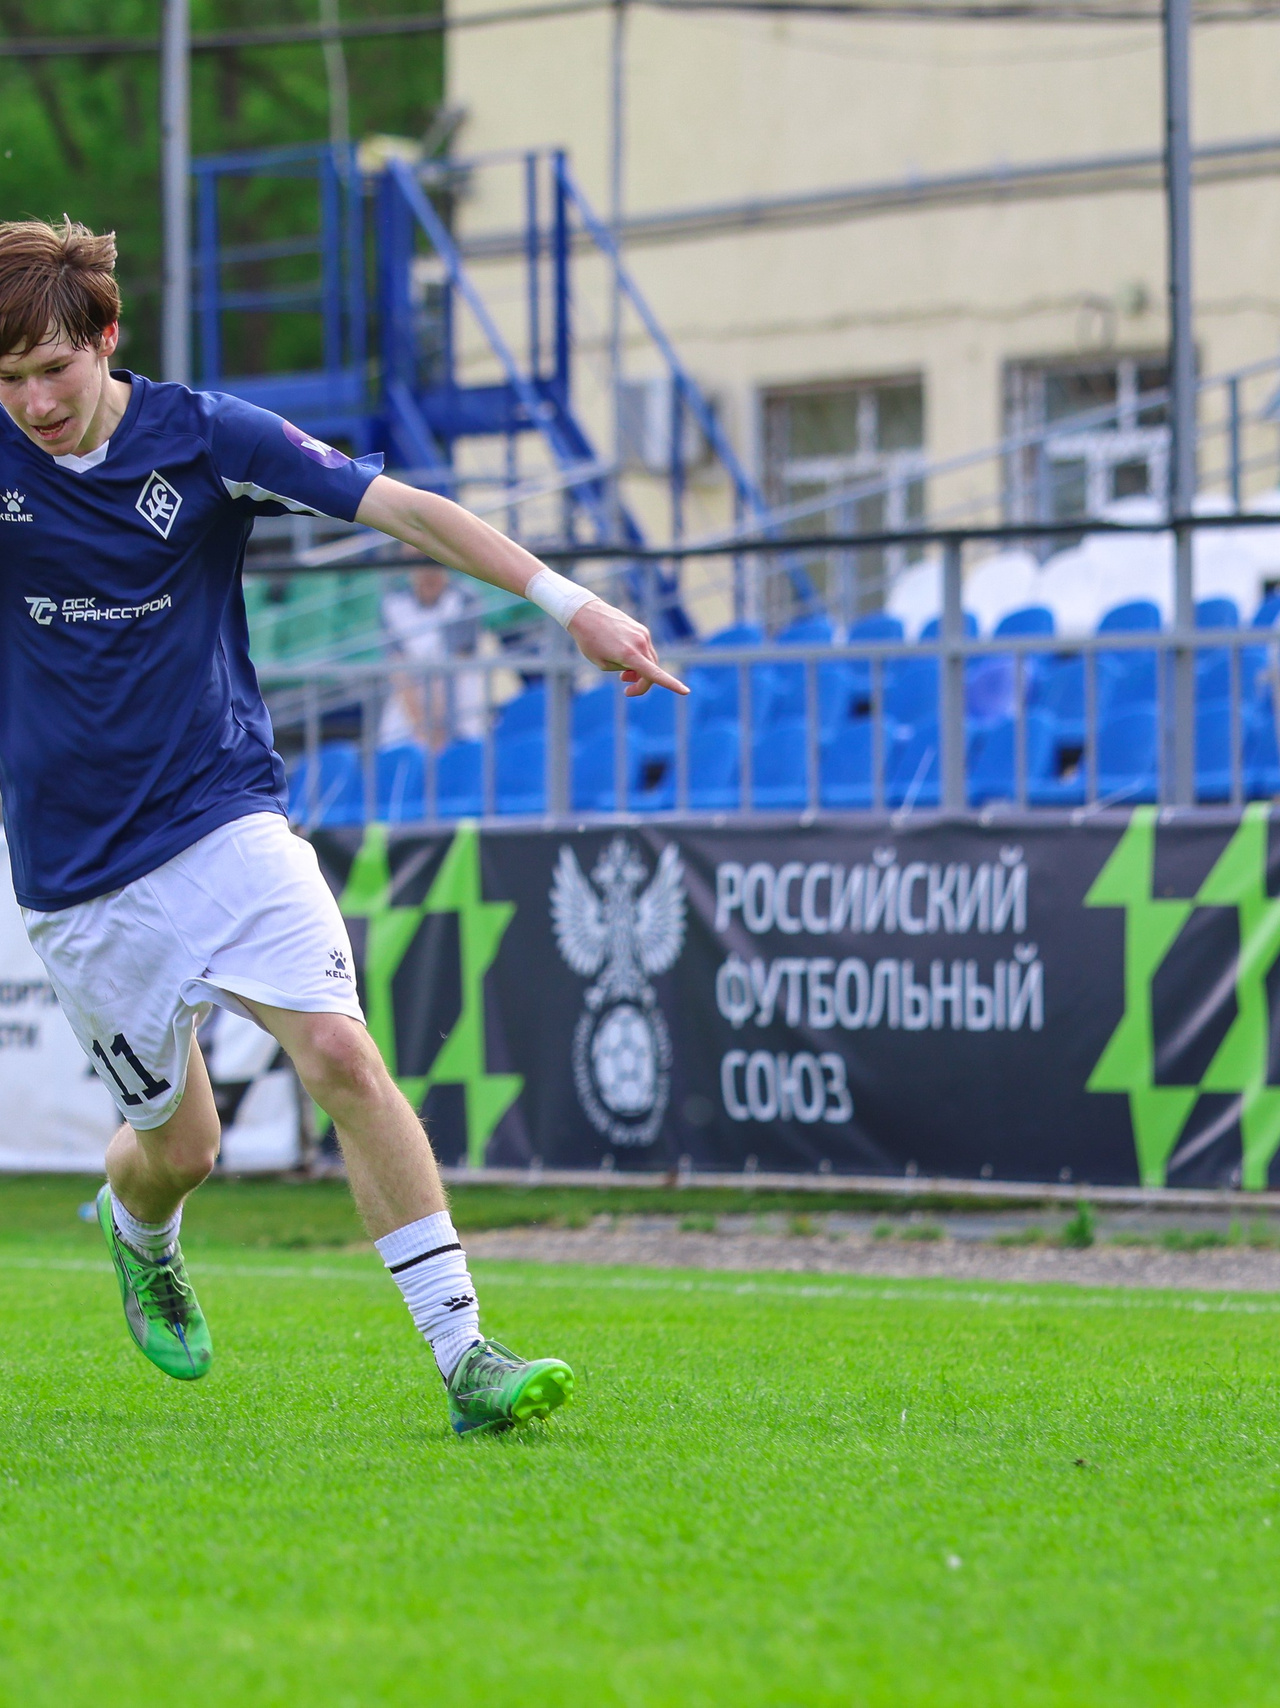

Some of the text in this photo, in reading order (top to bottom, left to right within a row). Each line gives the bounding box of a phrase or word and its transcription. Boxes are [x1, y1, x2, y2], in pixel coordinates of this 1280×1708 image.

[61, 597, 97, 611] ДСК
[61, 594, 172, 623] ТРАНССТРОЙ
[716, 846, 1027, 935] РОССИЙСКИЙ
[716, 943, 1043, 1031] ФУТБОЛЬНЫЙ
[92, 1033, 172, 1106] 11
[721, 1050, 853, 1124] СОЮЗ
